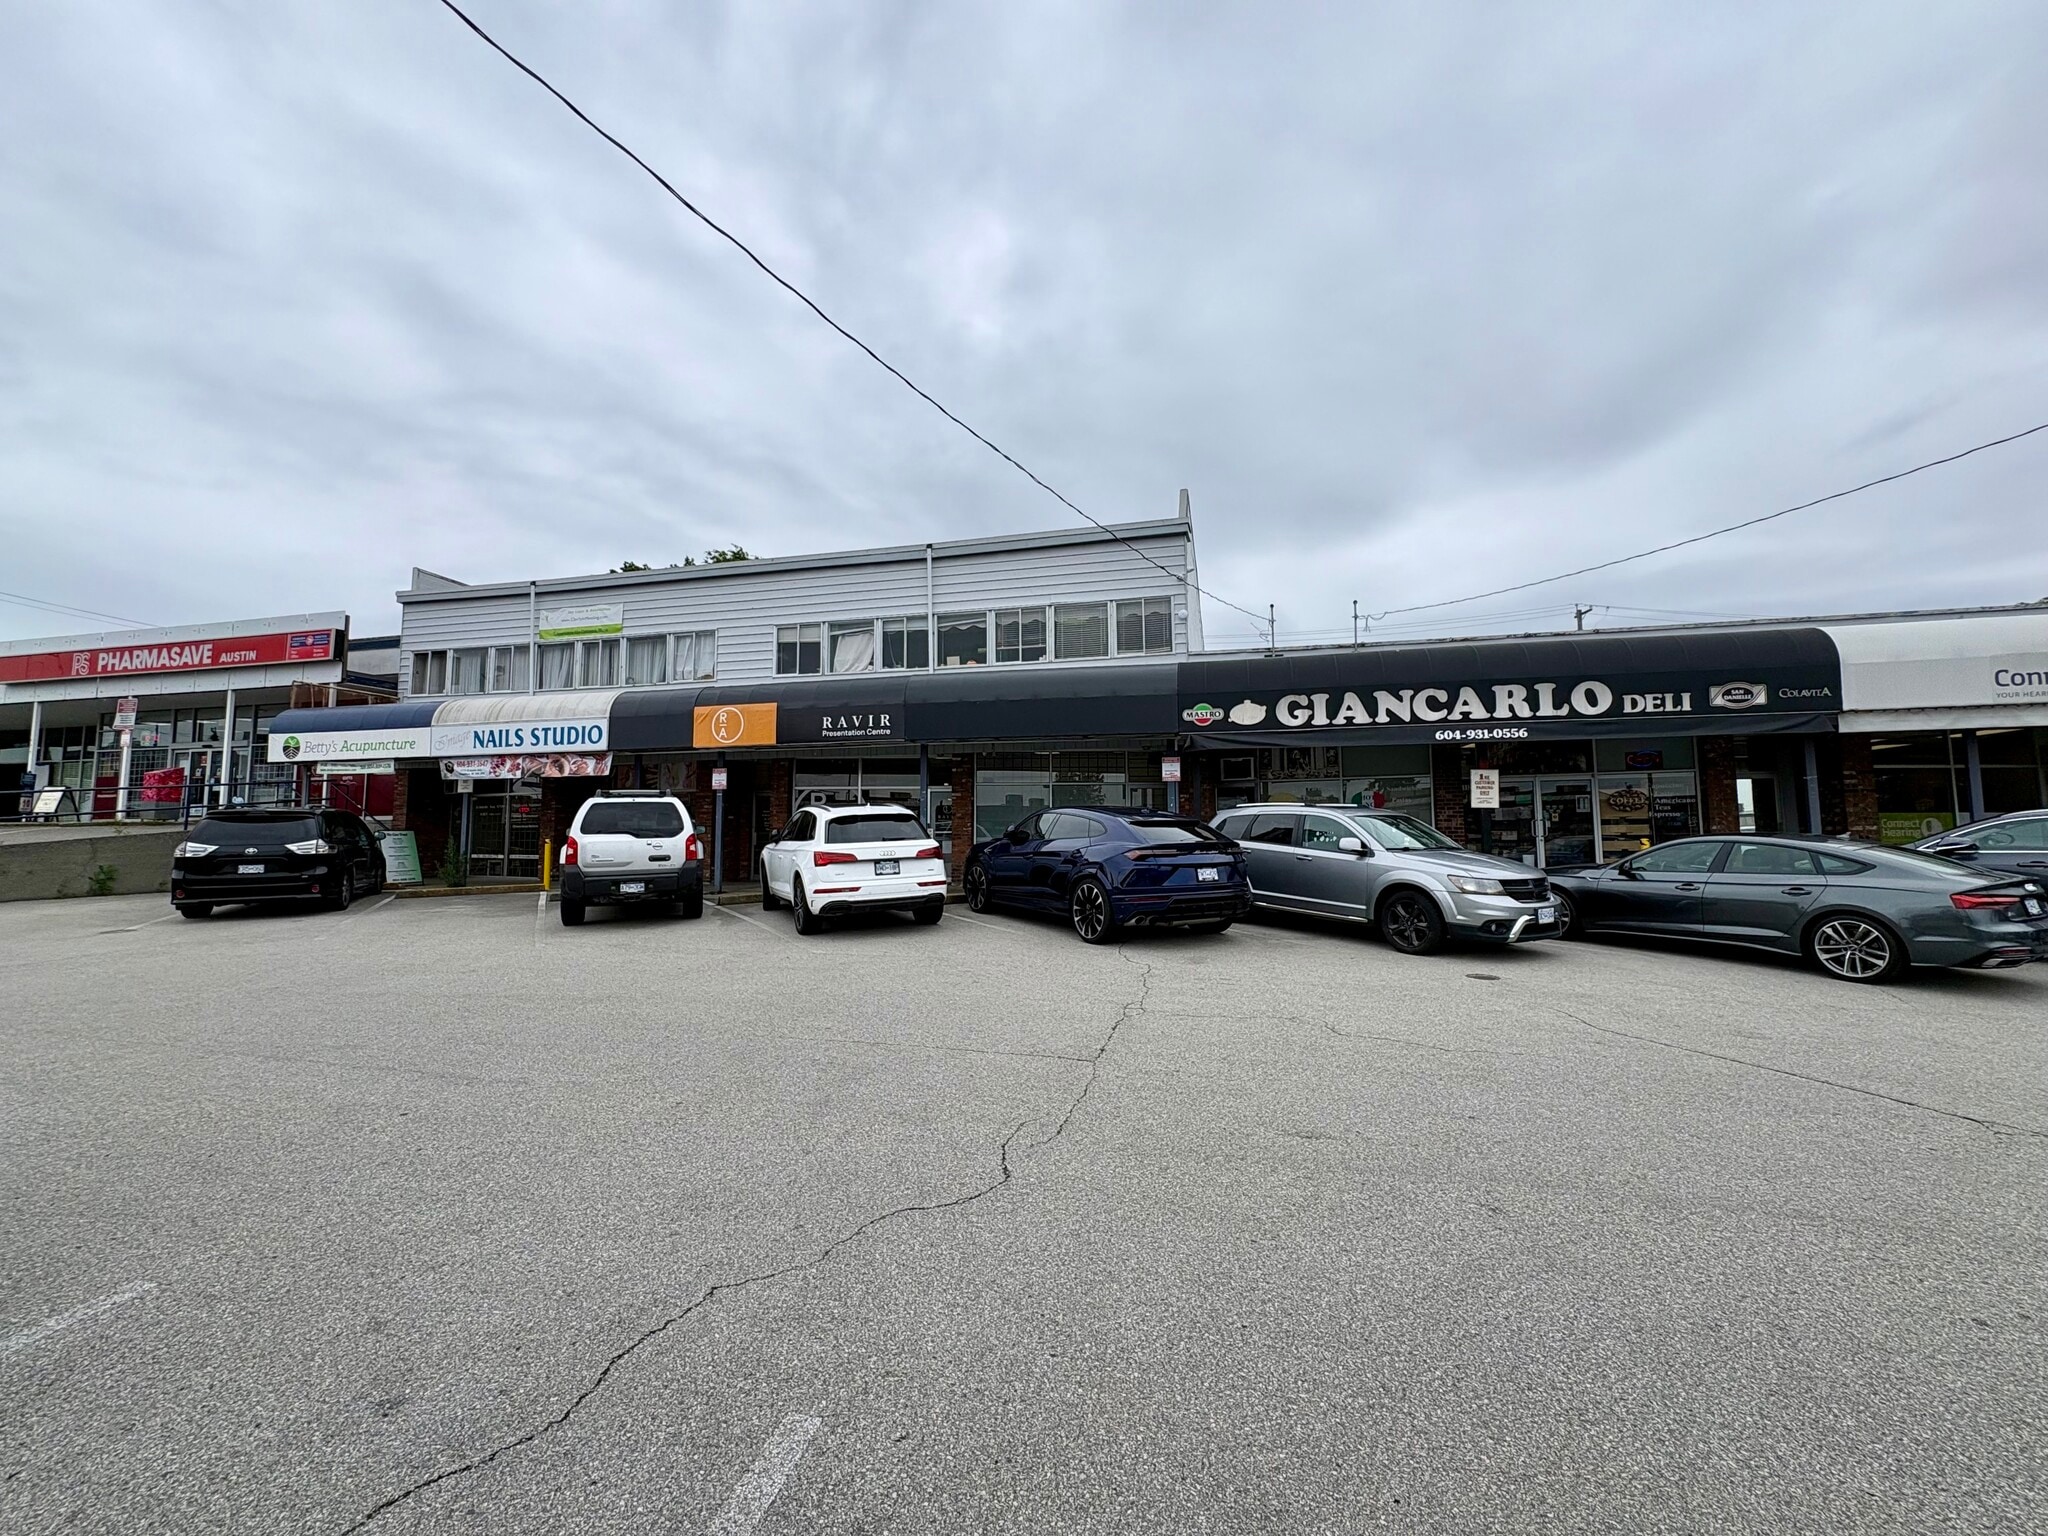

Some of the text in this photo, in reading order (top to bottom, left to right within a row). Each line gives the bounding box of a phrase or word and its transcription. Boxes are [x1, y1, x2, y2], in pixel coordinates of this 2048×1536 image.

[97, 643, 257, 672] PHARMASAVE AUSTIN
[1275, 681, 1692, 727] GIANCARLO DELI
[719, 712, 728, 723] R
[1186, 710, 1221, 718] MASTRO
[822, 714, 891, 728] RAVIR
[473, 728, 524, 749] NAILS
[530, 725, 603, 746] STUDIO
[719, 727, 728, 739] A
[822, 729, 866, 737] Presentation
[1435, 728, 1528, 741] 604-931-0556
[303, 740, 416, 756] Betty's Acupuncture
[1881, 819, 1920, 828] Connect
[1882, 829, 1921, 838] Hearing
